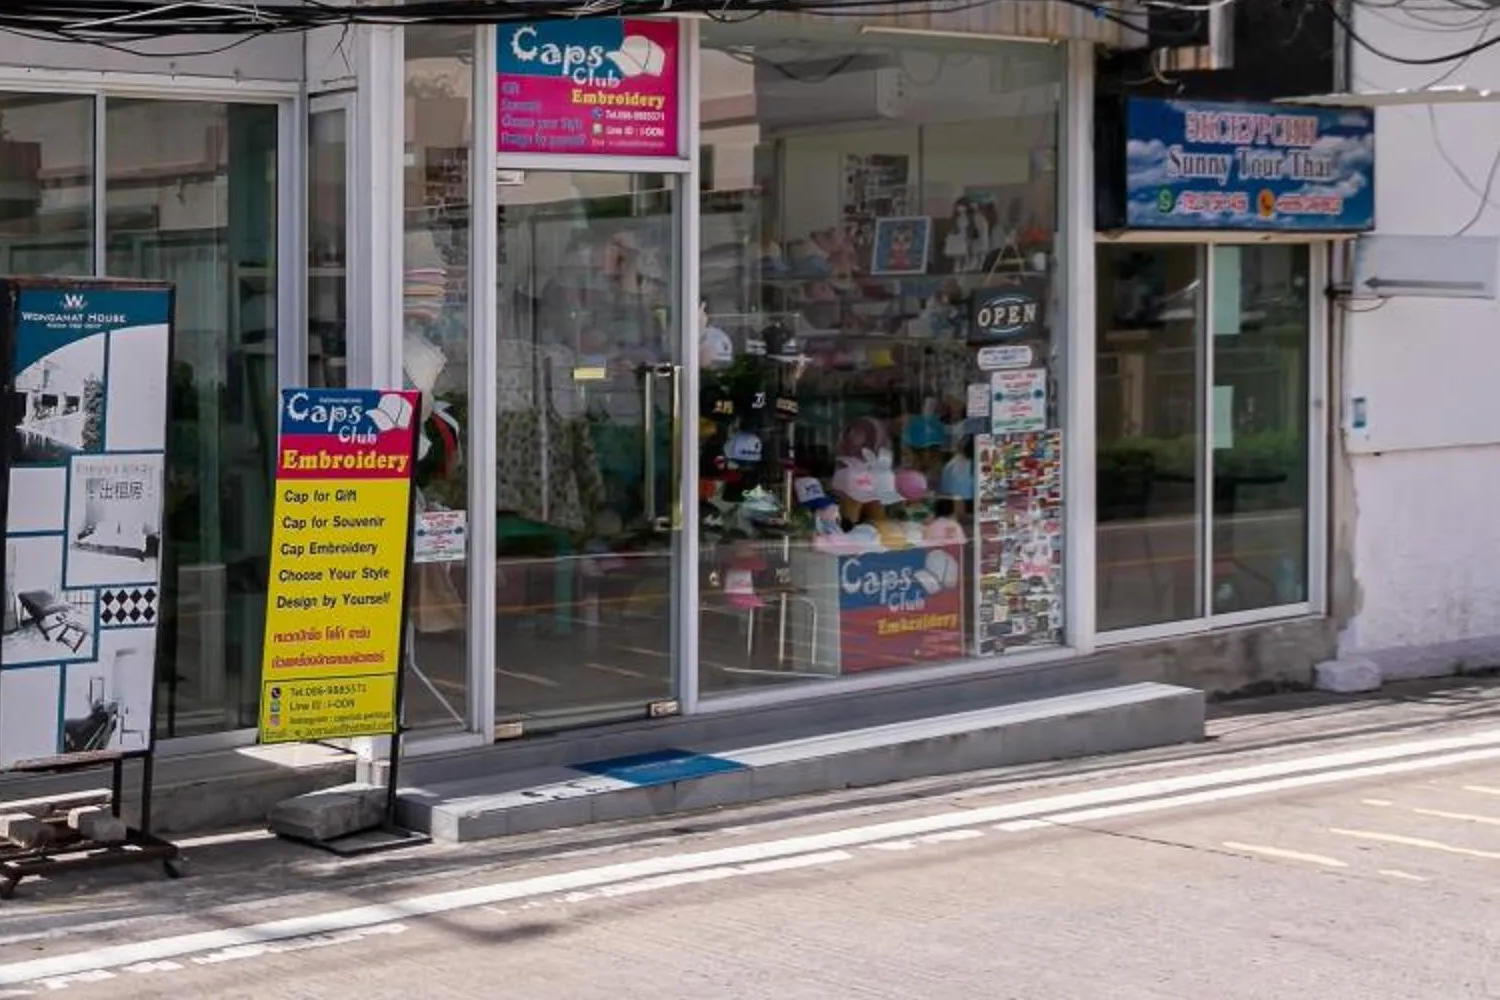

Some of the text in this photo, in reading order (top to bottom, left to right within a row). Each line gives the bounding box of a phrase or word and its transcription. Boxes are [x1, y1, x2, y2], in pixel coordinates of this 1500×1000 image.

[510, 25, 604, 75] Caps
[573, 68, 620, 87] Club
[572, 88, 665, 109] Embroidery
[1168, 146, 1231, 184] Sunny
[1238, 149, 1282, 178] Tour
[978, 303, 1036, 327] OPEN
[287, 392, 363, 432] Caps
[338, 426, 377, 444] Club
[282, 449, 409, 473] Embroidery
[284, 490, 357, 504] Cap for Gift
[282, 516, 386, 530] Cap for Souvenir
[280, 542, 378, 558] Cap Embroidery
[279, 567, 389, 582] Choose Your Style
[842, 558, 913, 605] Caps
[277, 592, 391, 610] Design by Yourself
[888, 590, 925, 612] Club
